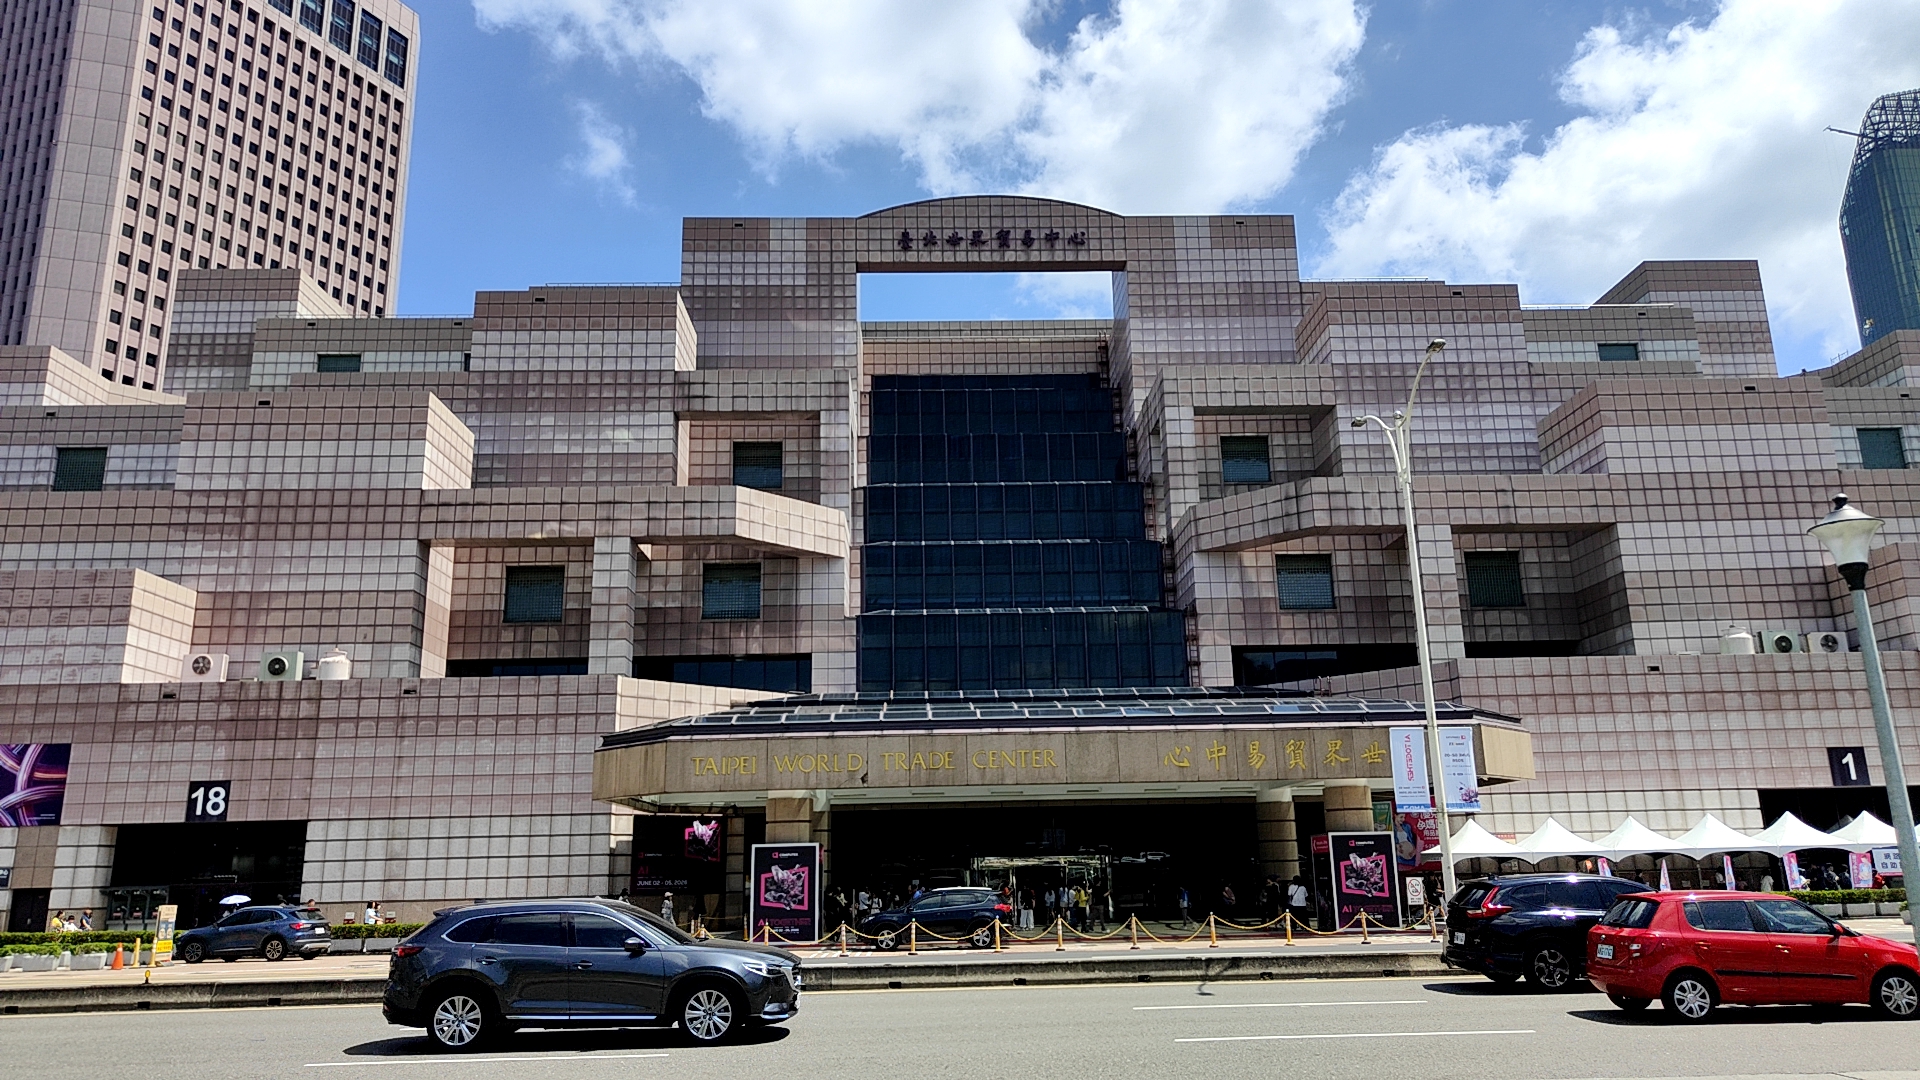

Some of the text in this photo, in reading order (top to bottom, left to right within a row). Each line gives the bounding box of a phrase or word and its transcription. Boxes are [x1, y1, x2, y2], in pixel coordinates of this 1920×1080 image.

[899, 229, 1086, 250] 臺北世界貿易中心
[692, 749, 1058, 775] TAIPEI WORLD TRADE CENTER
[1842, 752, 1857, 780] 1
[191, 786, 226, 816] 18
